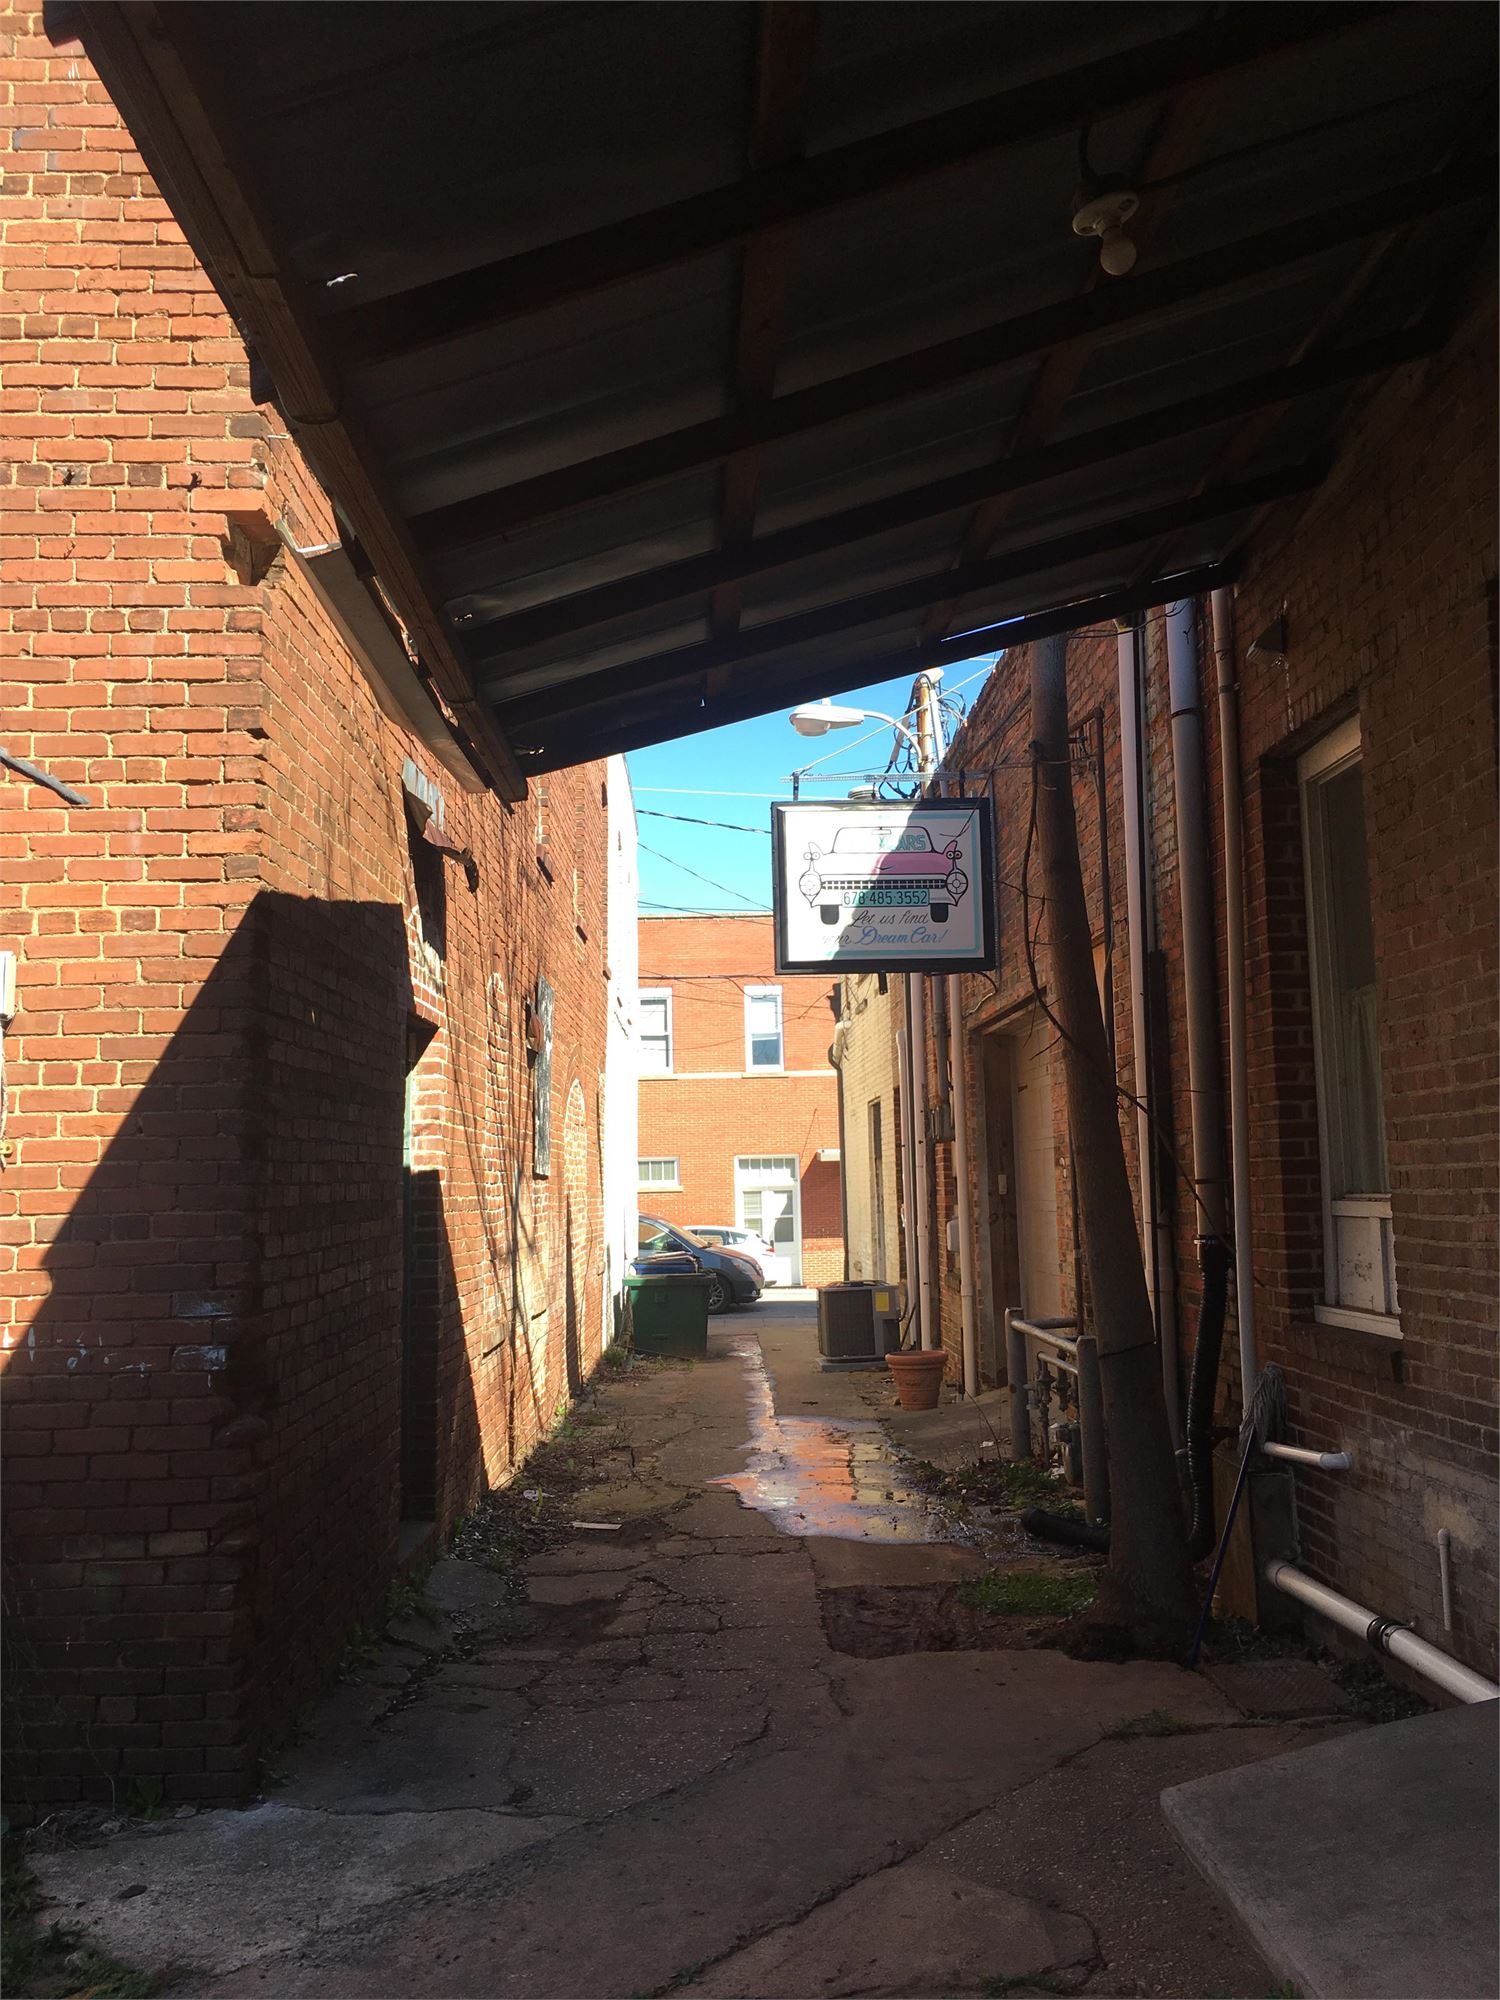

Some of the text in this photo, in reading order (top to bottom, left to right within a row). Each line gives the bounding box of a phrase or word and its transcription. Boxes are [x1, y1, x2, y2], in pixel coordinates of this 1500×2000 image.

[848, 909, 930, 928] Let us find
[854, 925, 909, 946] Dream
[909, 926, 948, 944] Car!
